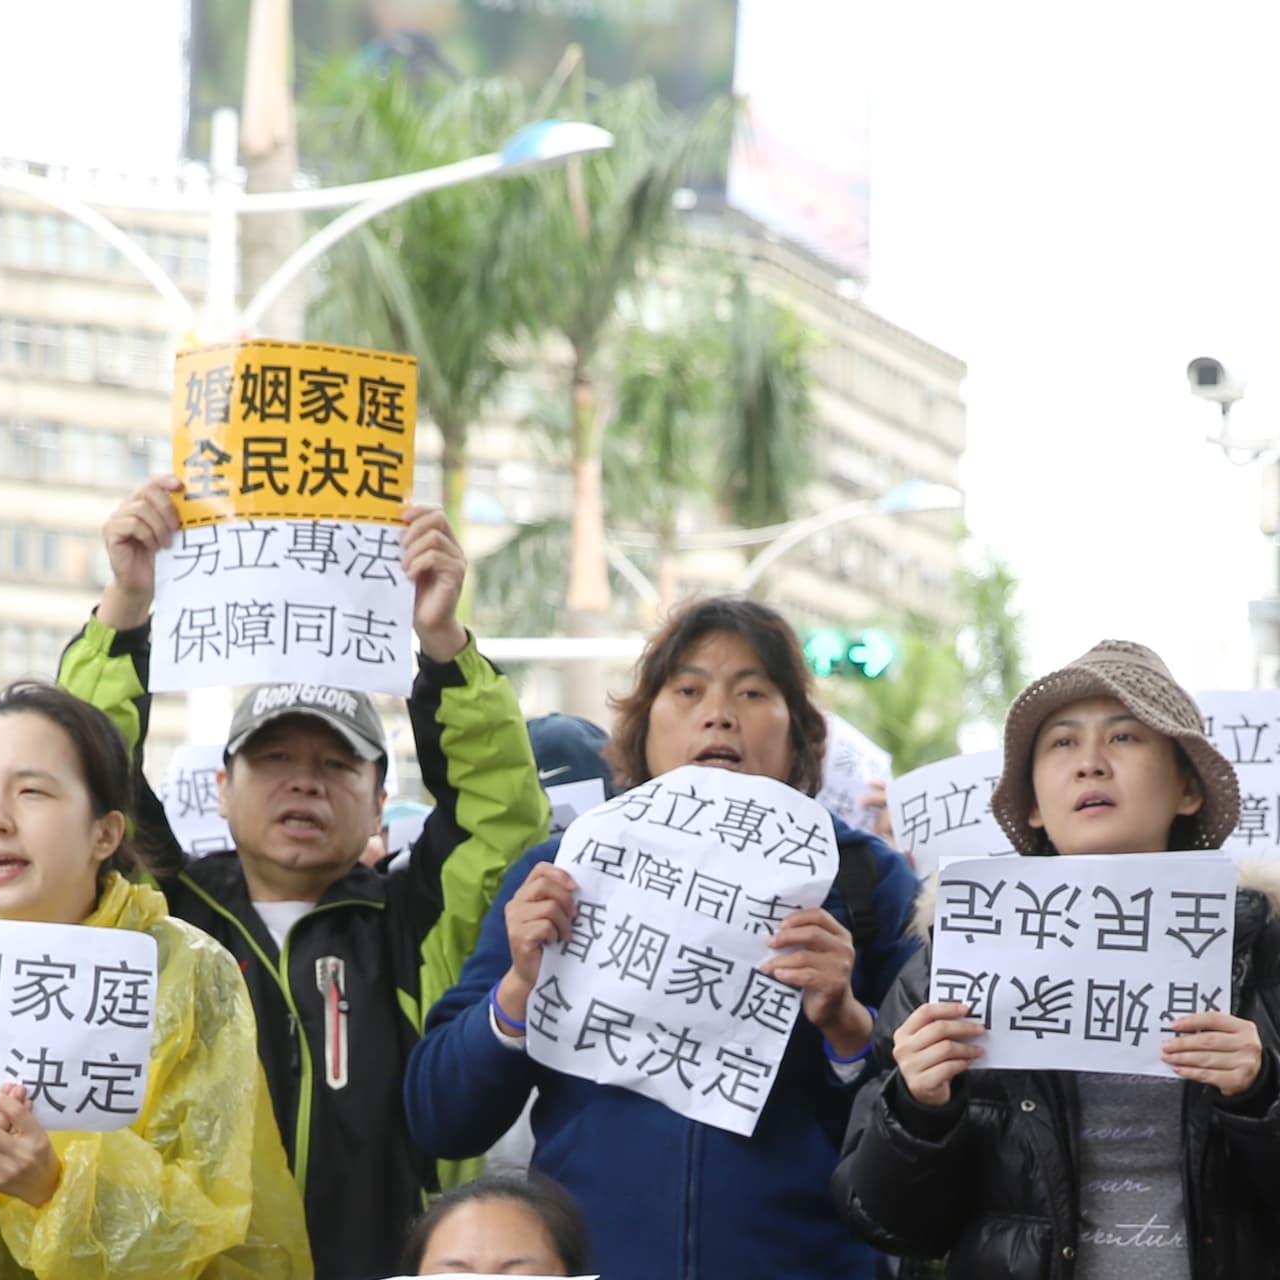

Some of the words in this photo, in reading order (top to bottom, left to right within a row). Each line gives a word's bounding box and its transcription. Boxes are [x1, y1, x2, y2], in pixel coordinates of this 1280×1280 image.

[184, 364, 405, 434] 婚姻家庭
[184, 437, 404, 502] 全民決定
[173, 521, 403, 587] 另立專法
[168, 598, 398, 666] 保障同志
[252, 684, 298, 716] BODY
[299, 682, 358, 718] GLOVE
[593, 783, 829, 877] 另立專法
[900, 774, 1002, 858] 另立
[940, 879, 1228, 960] 全民決定
[528, 973, 774, 1113] 全民決定
